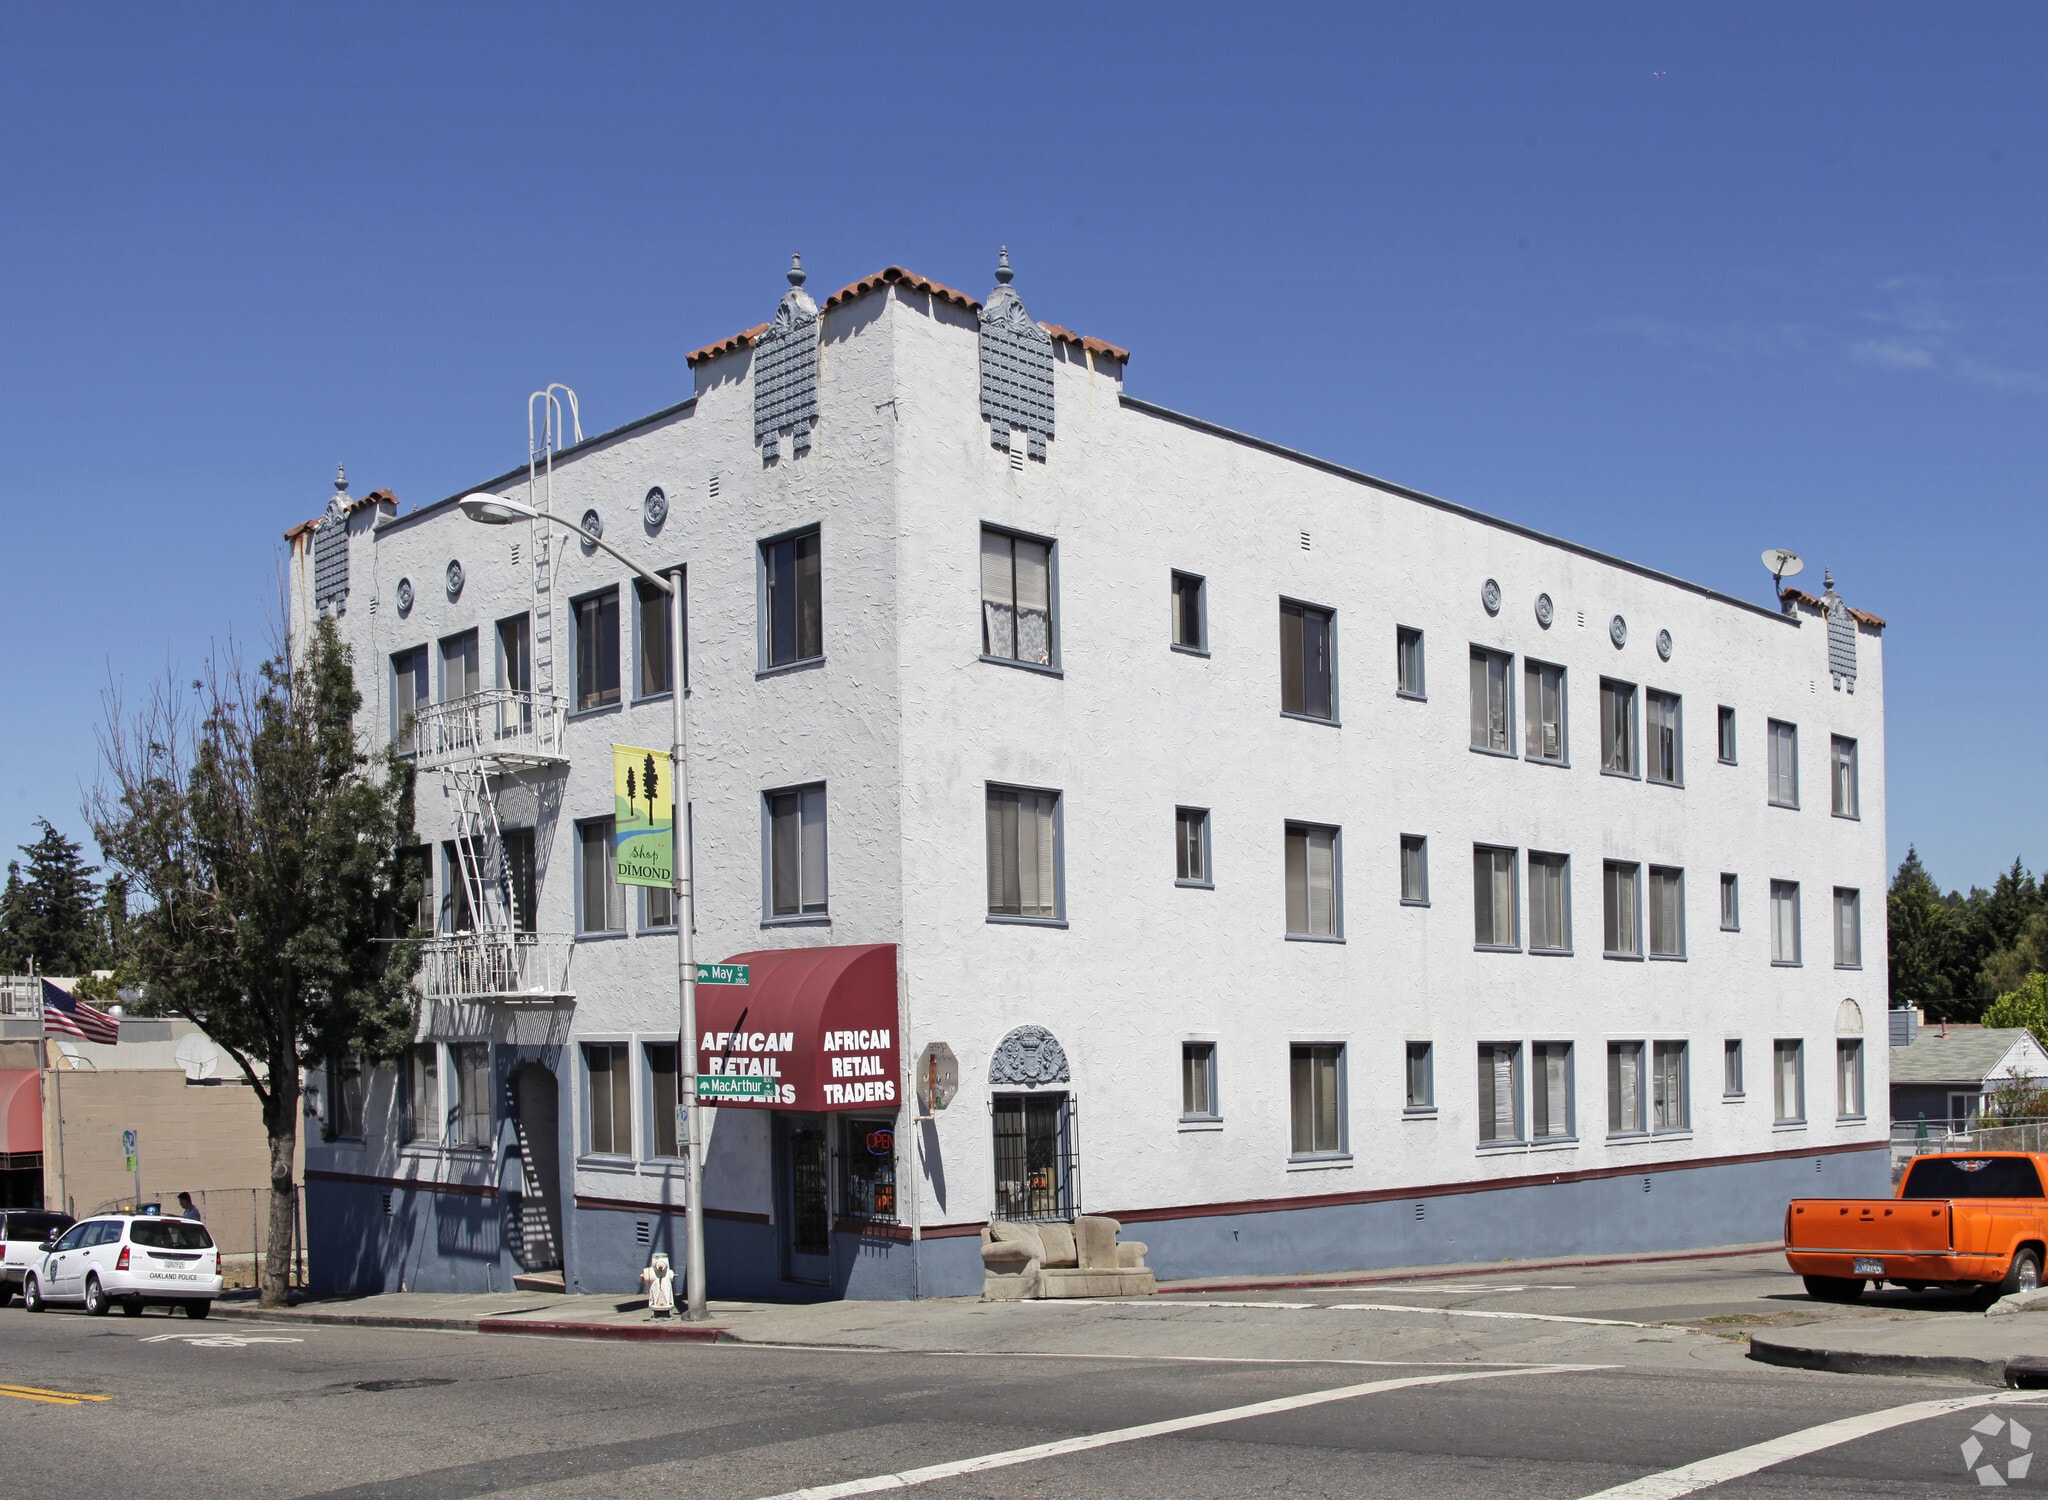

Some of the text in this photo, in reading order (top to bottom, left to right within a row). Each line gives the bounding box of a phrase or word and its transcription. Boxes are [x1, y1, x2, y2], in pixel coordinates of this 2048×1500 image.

[629, 844, 659, 866] Shop
[617, 863, 671, 880] DIMOND
[711, 966, 733, 983] May
[700, 1032, 795, 1052] AFRICAN
[823, 1029, 891, 1051] AFRICAN
[709, 1056, 782, 1078] RETAIL
[832, 1055, 885, 1078] RETAIL
[711, 1079, 762, 1093] MacArthur
[823, 1080, 896, 1105] TRADERS
[149, 1272, 198, 1281] OAKLAND POLICE
